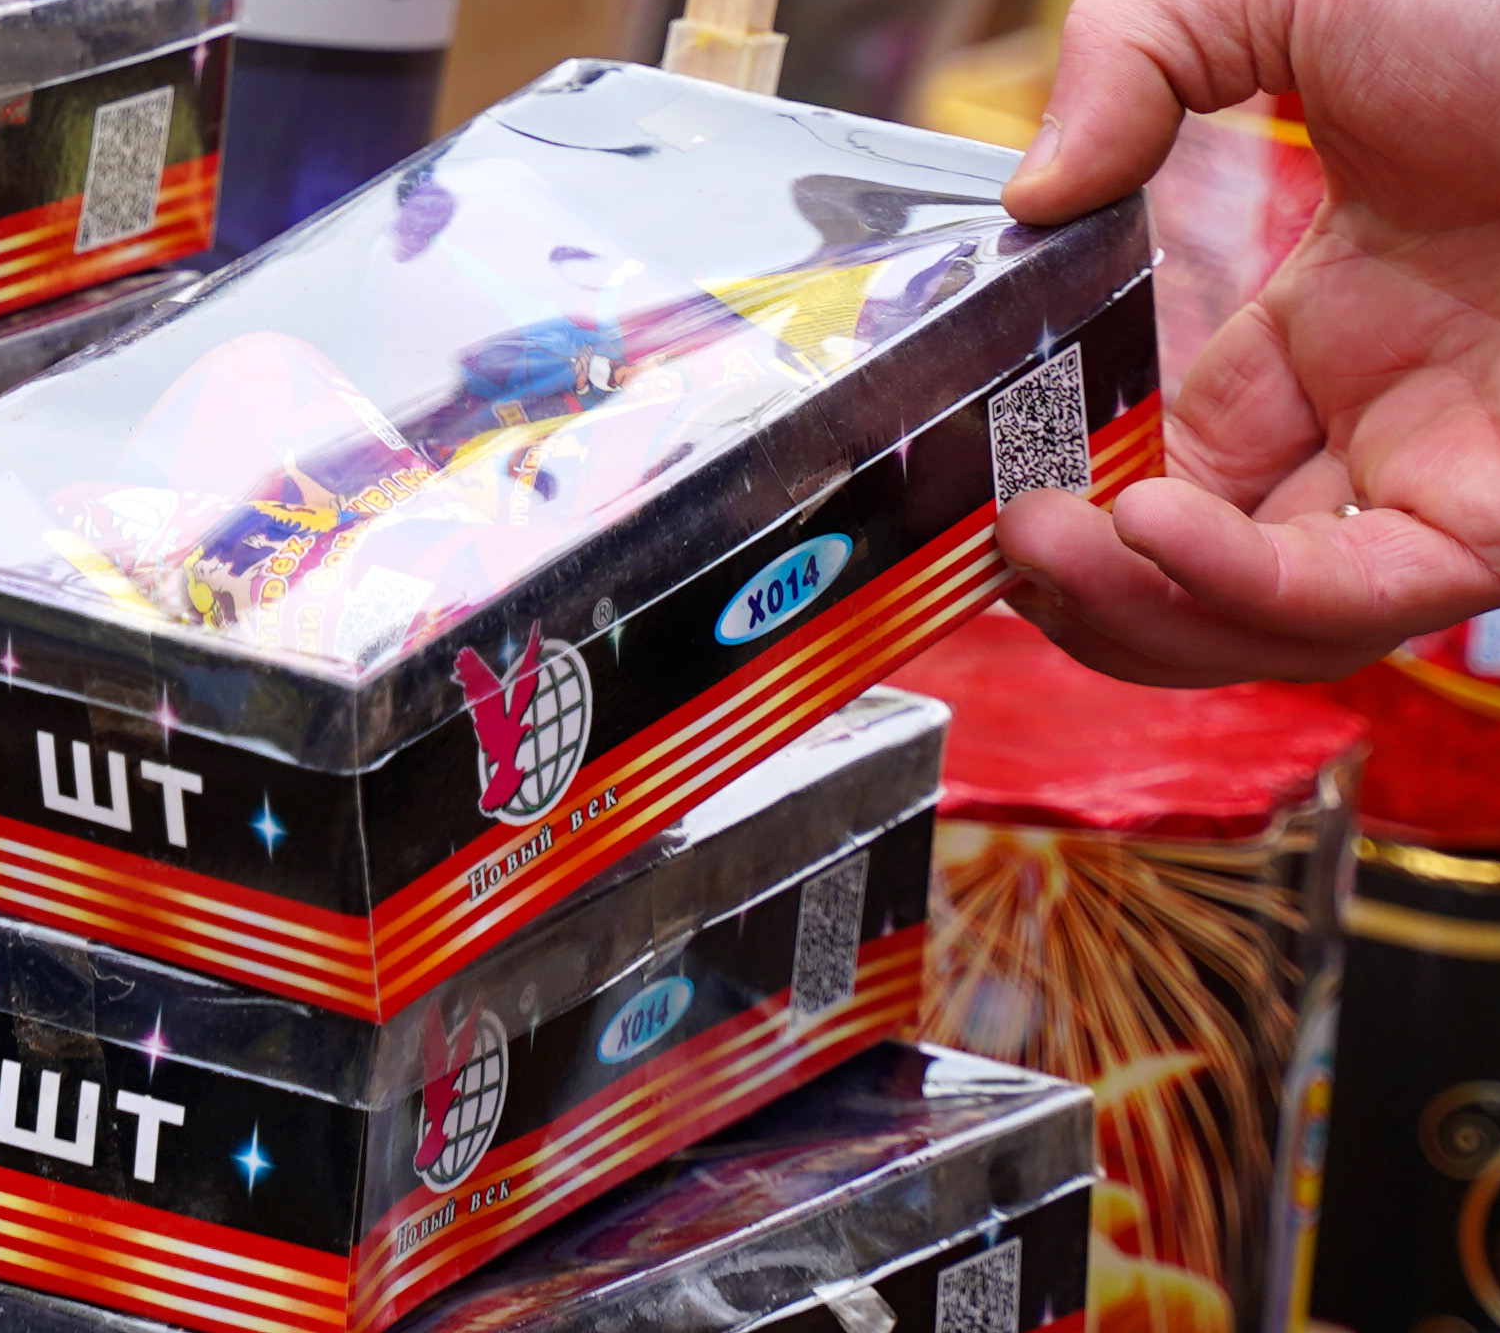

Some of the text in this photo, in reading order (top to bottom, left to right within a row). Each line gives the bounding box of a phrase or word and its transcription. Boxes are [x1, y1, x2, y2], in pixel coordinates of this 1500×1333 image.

[746, 554, 821, 630] X014
[467, 786, 619, 903] Новый век
[395, 1177, 513, 1261] Новый век
